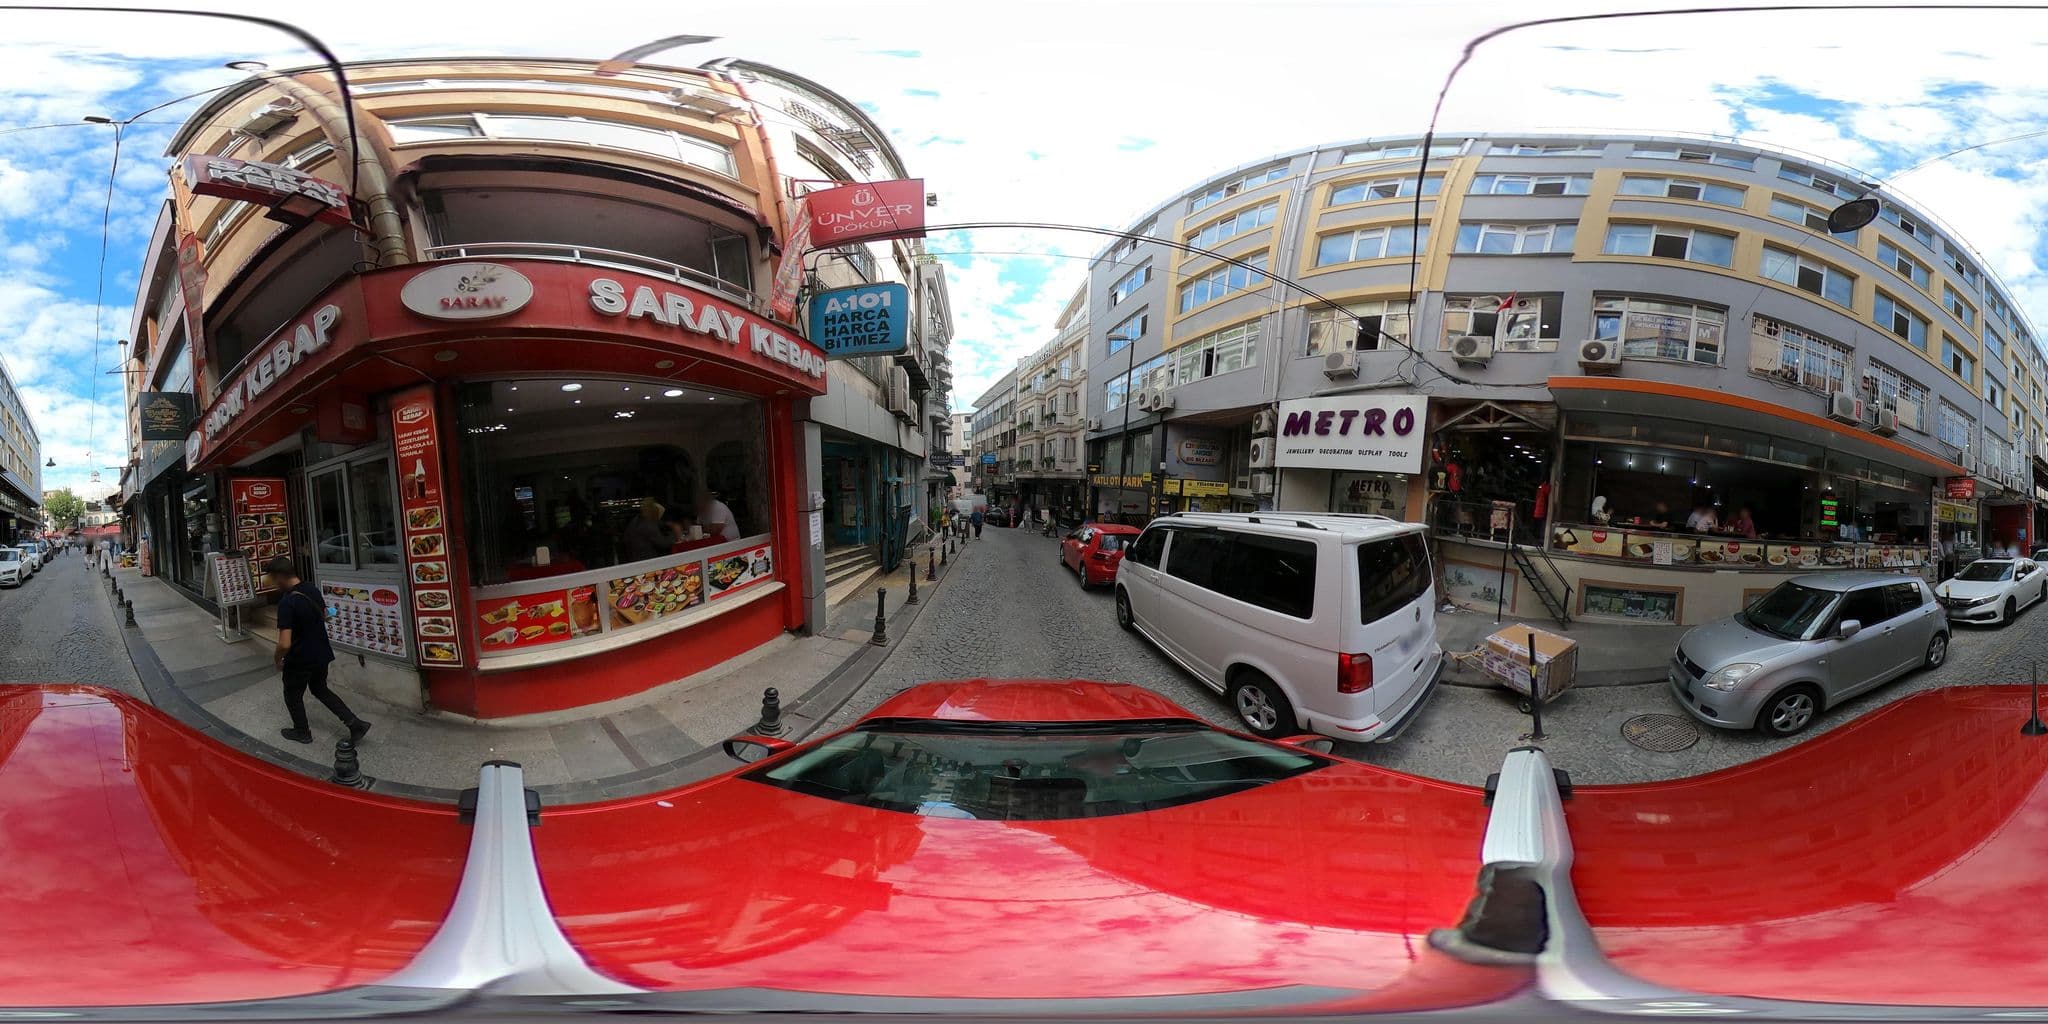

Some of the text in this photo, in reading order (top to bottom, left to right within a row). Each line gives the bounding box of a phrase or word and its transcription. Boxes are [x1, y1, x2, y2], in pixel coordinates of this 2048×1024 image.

[207, 160, 343, 198] SARAY
[208, 168, 346, 208] KEBAP
[817, 204, 913, 226] ÜNVER
[833, 219, 897, 234] DÖKÜM
[439, 296, 507, 310] SARAY
[824, 308, 890, 326] HARCA
[589, 278, 745, 345] SARAY
[750, 322, 826, 379] KEBAP
[824, 320, 890, 338] HARCA
[205, 380, 245, 441] SARAY
[246, 304, 342, 402] KEBAP
[1283, 407, 1415, 437] METRO
[1358, 449, 1382, 457] DISPLAY
[1388, 450, 1408, 458] TOOLS
[1122, 475, 1143, 487] PARK
[1351, 479, 1389, 493] METRO
